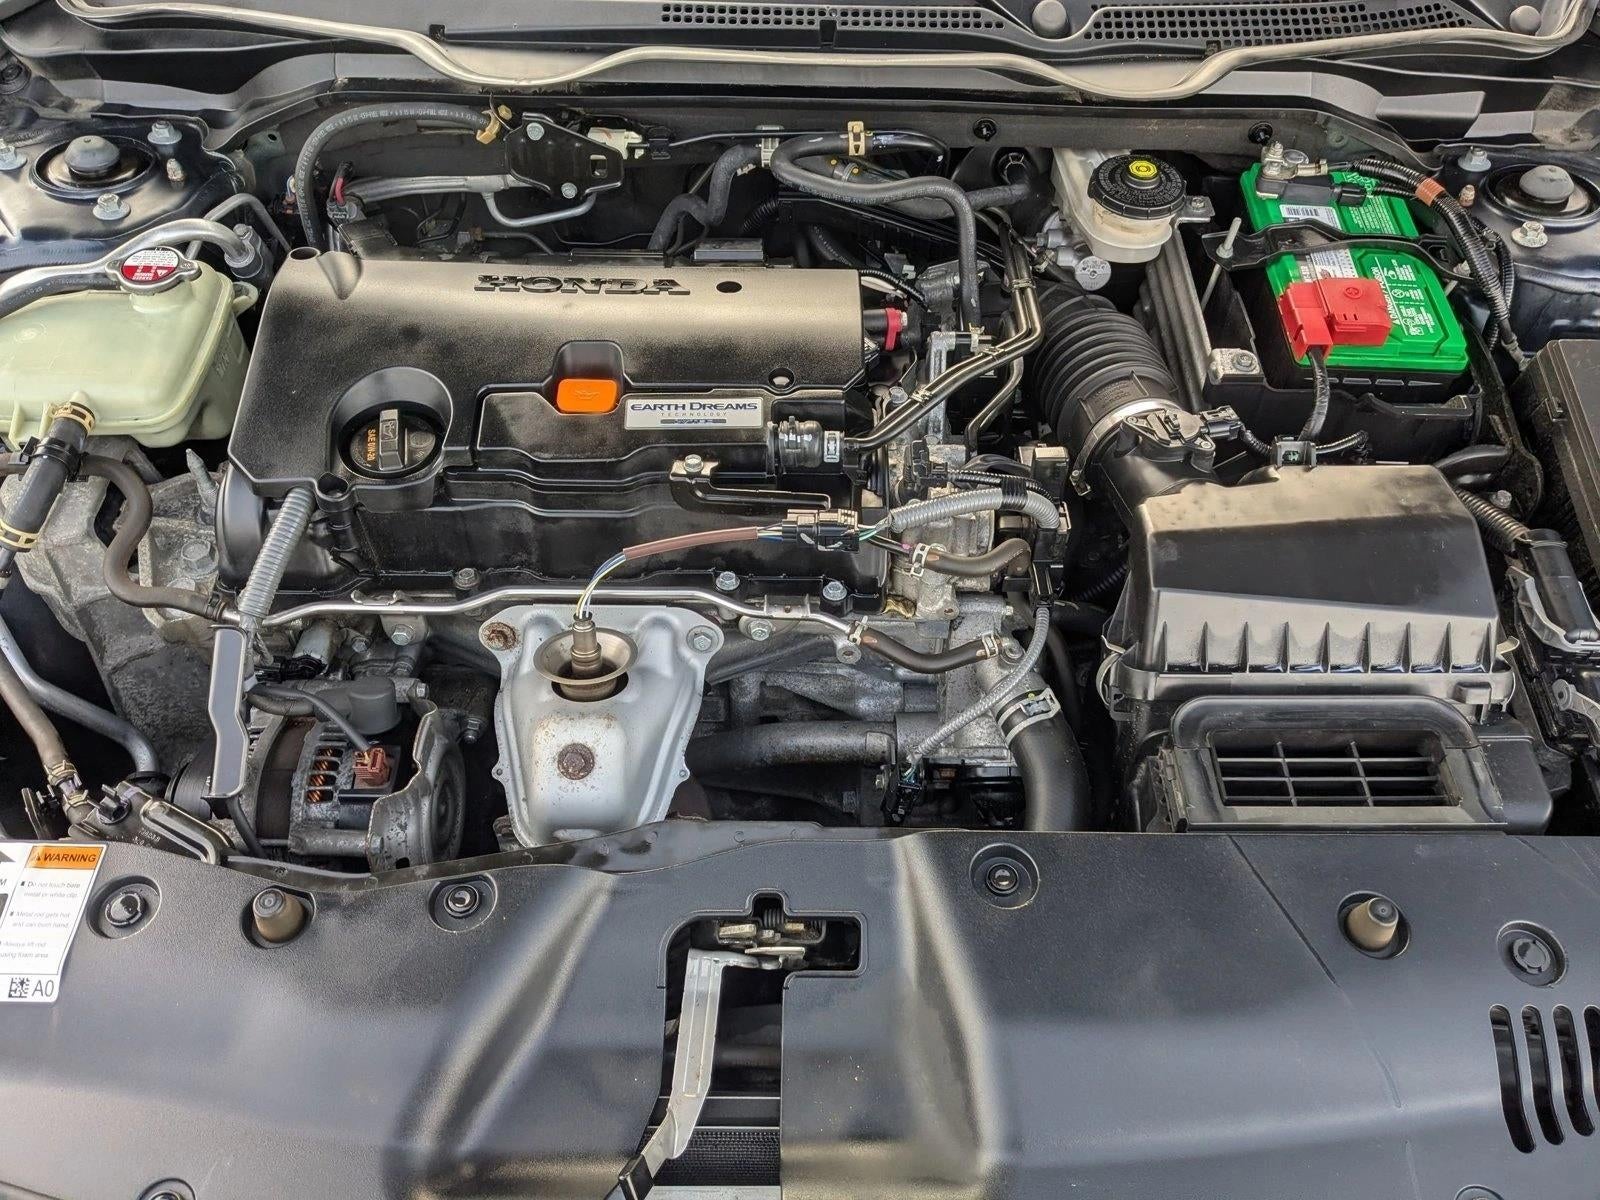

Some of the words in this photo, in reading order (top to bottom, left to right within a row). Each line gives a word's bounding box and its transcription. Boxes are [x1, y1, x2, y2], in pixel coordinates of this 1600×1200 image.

[473, 274, 691, 295] HONDA
[630, 403, 686, 411] EARTH
[689, 402, 758, 411] DREAMS
[367, 429, 376, 442] SAE
[44, 853, 97, 863] WARNING
[48, 881, 66, 889] touch
[31, 979, 55, 997] A0
